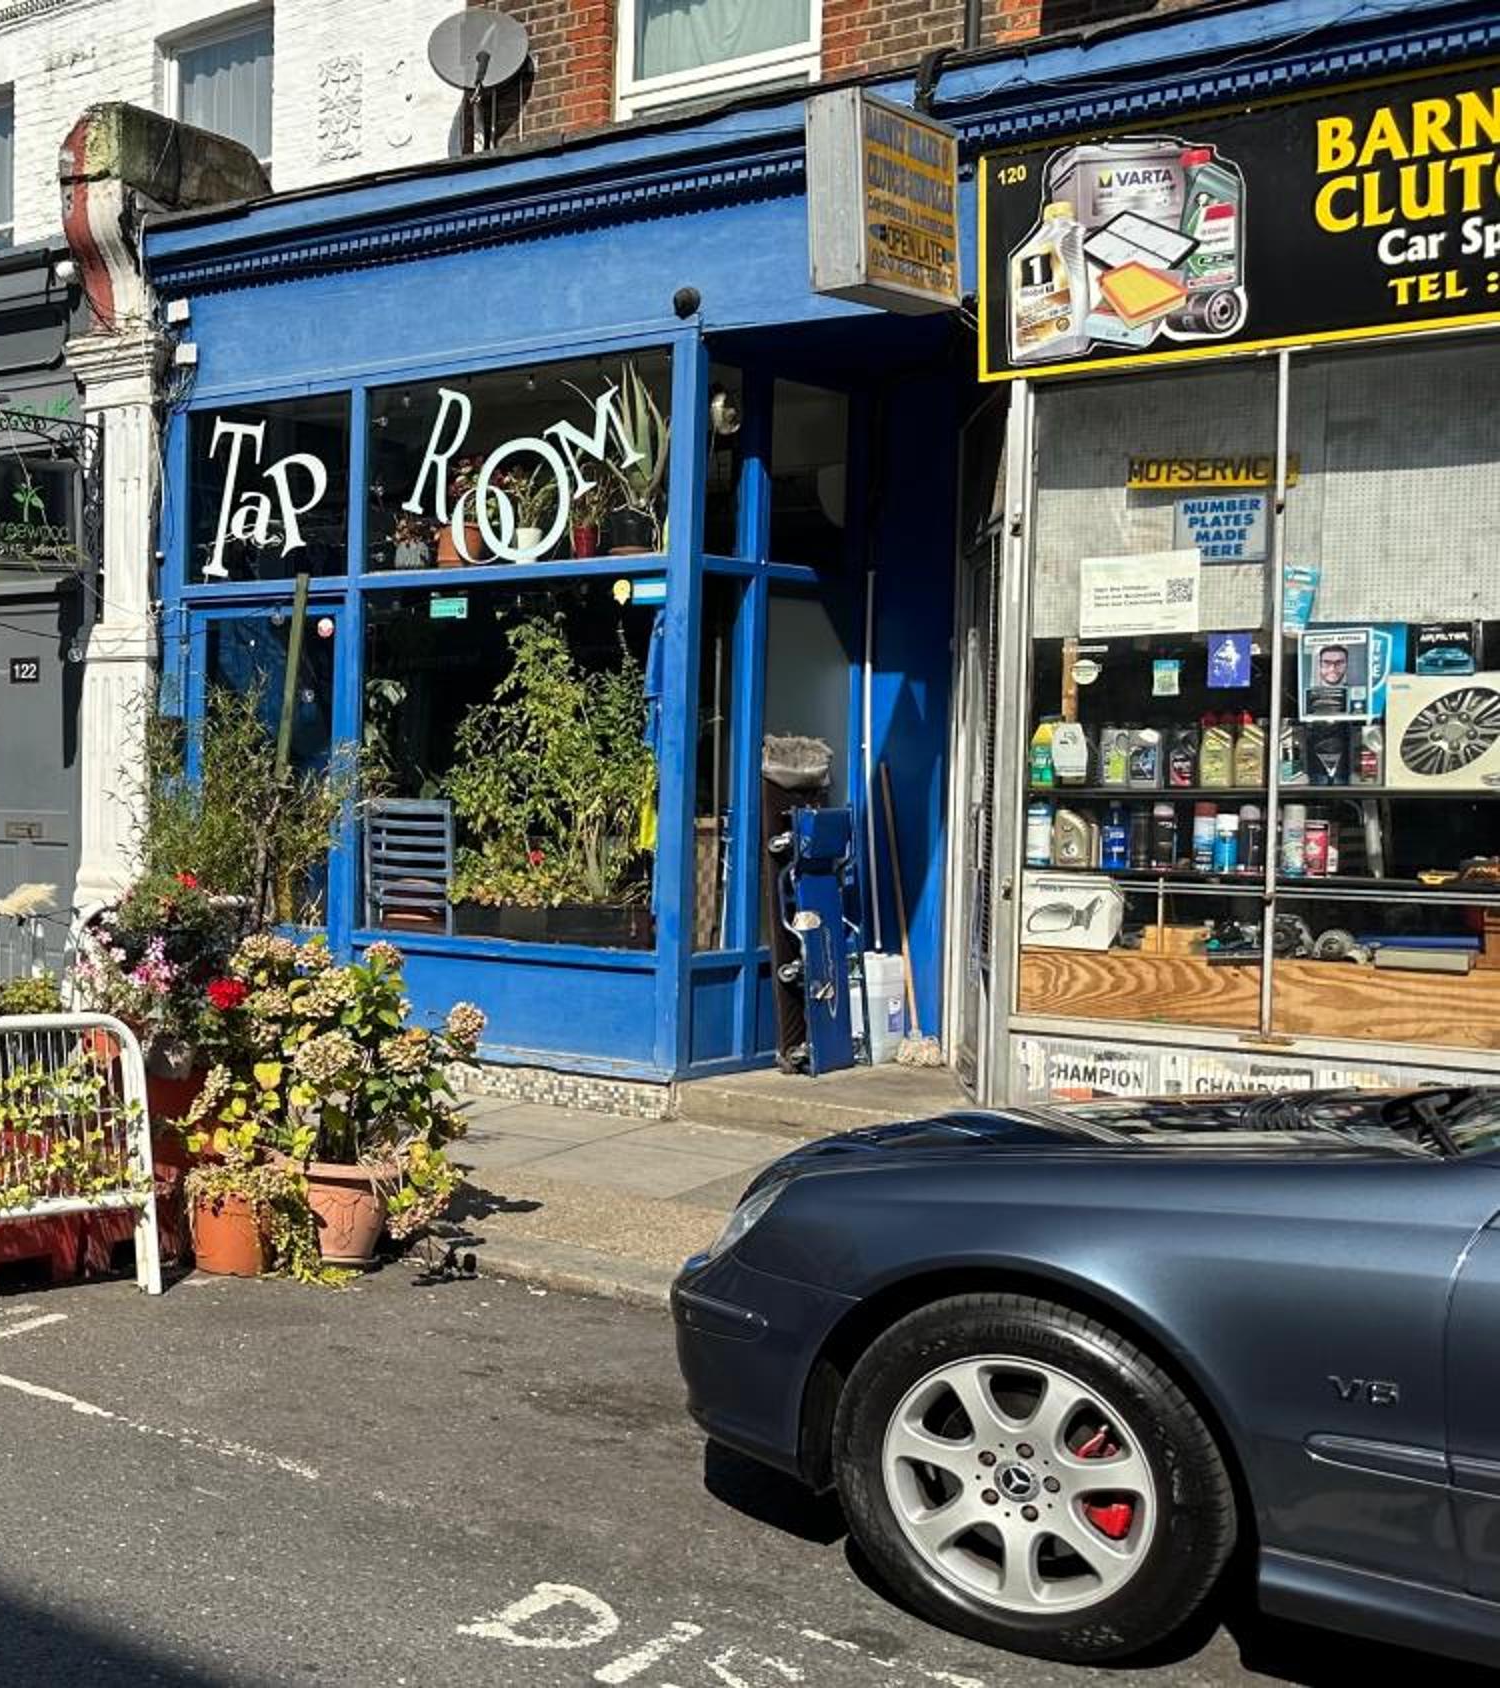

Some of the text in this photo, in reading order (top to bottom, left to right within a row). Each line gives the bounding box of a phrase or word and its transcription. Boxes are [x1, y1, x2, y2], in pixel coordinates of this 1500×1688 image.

[997, 165, 1027, 186] 120
[1116, 169, 1173, 188] VARTA
[1315, 152, 1500, 233] CLUT
[1377, 227, 1447, 266] Car
[1387, 270, 1468, 305] TEL
[402, 385, 646, 565] ROOM
[1183, 498, 1261, 515] NUMBER
[1188, 513, 1255, 529] PLATES
[1195, 529, 1247, 543] MADE
[13, 663, 37, 679] 122
